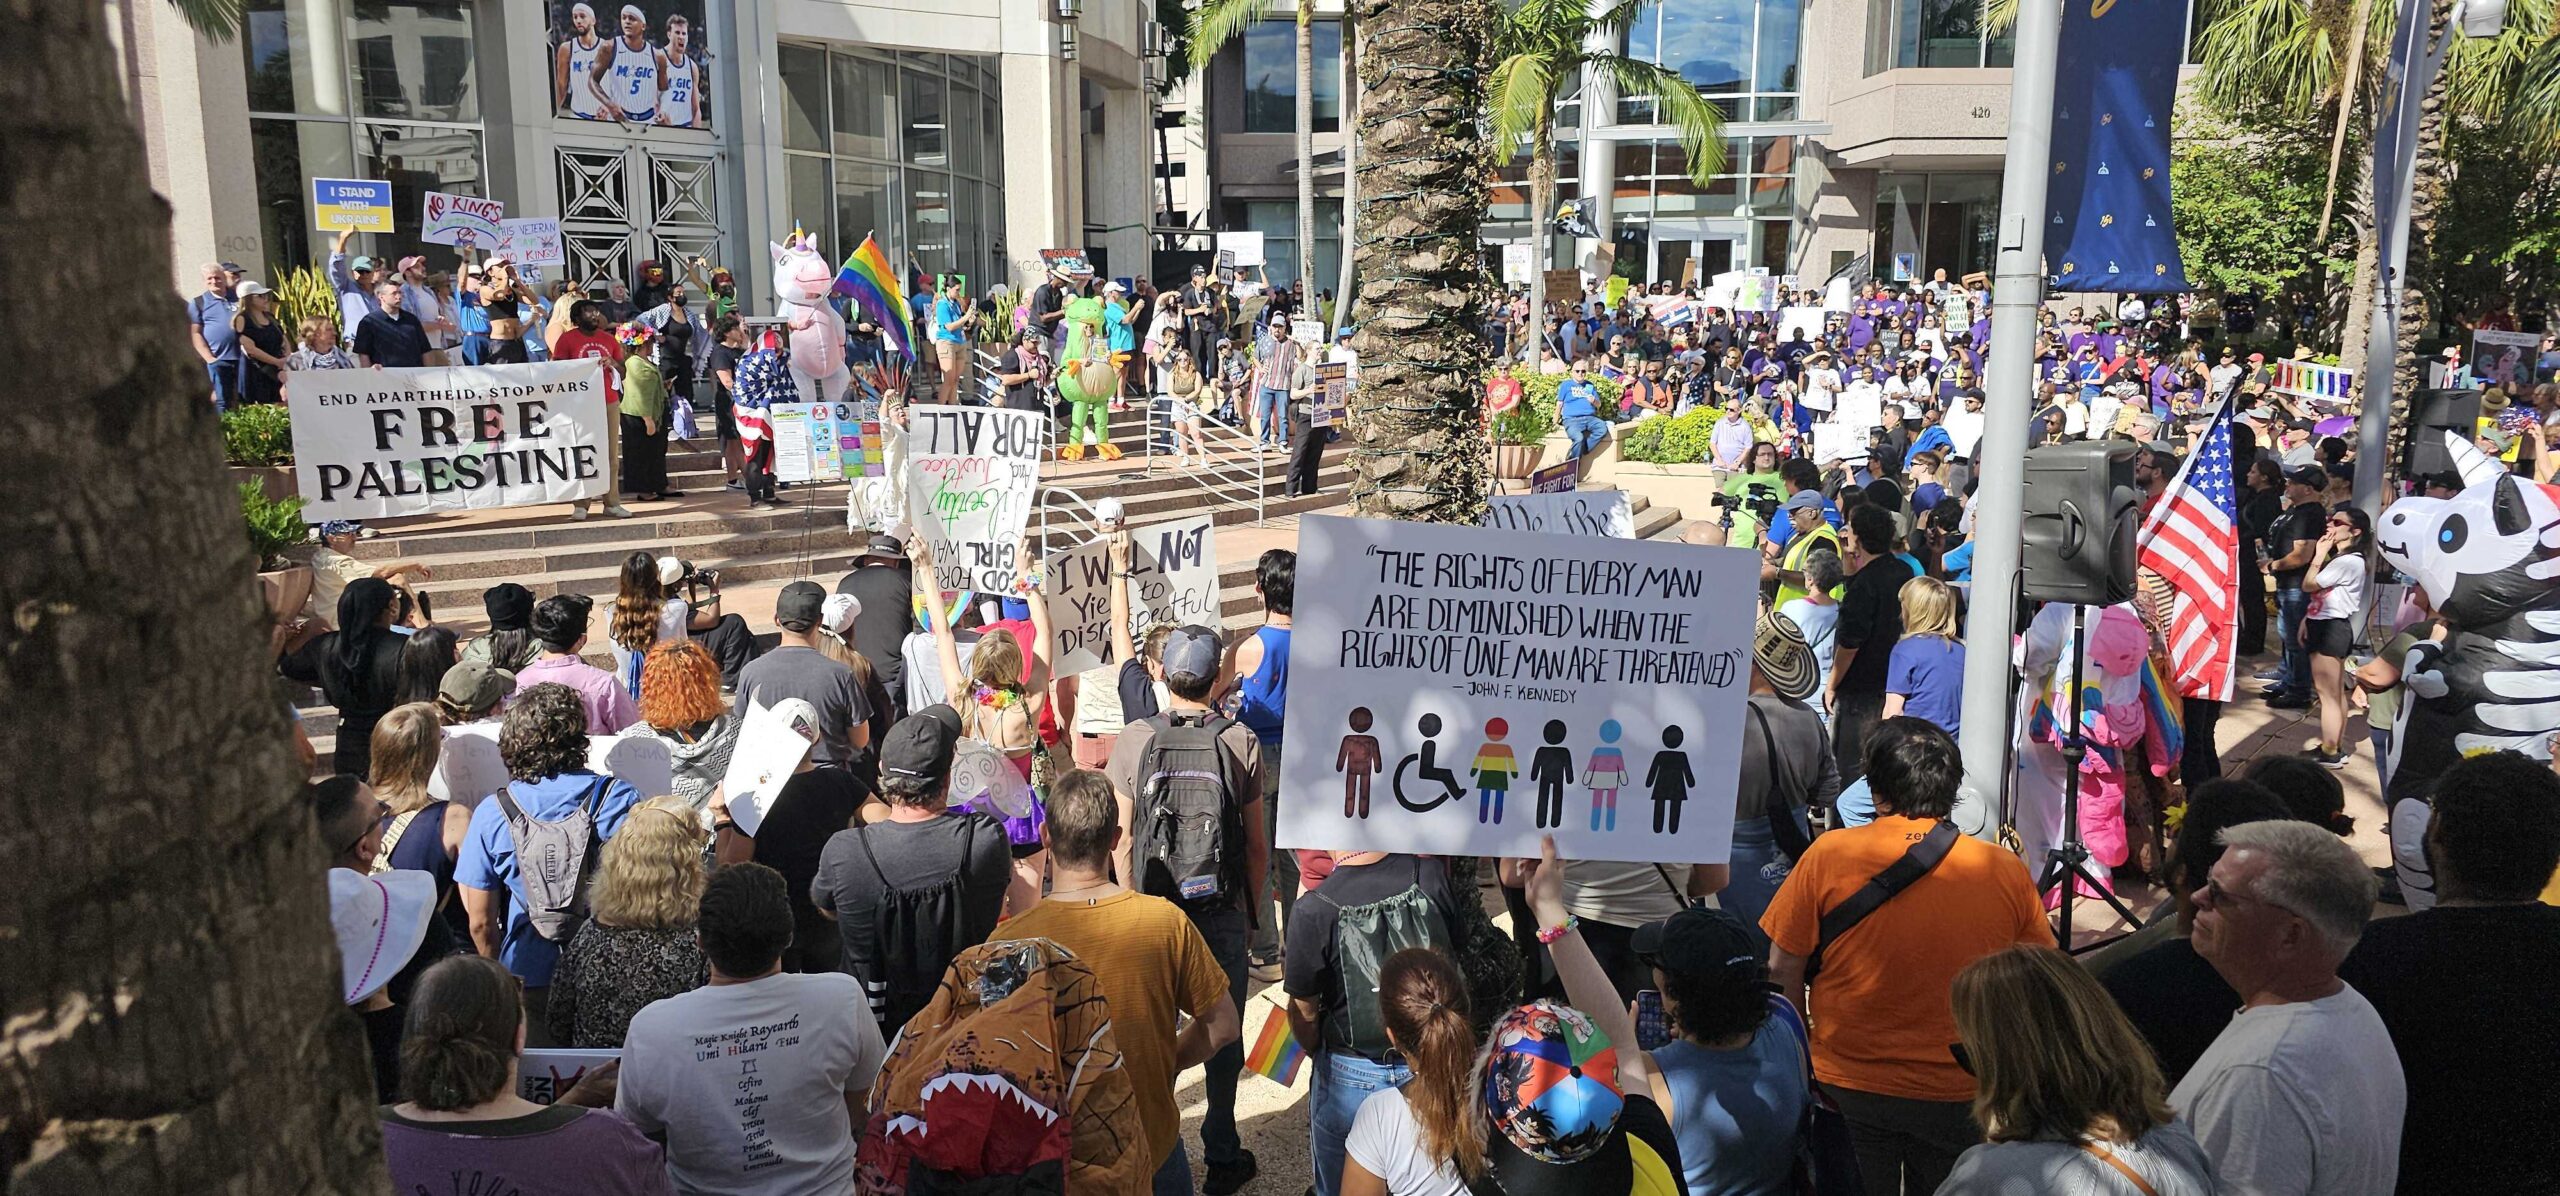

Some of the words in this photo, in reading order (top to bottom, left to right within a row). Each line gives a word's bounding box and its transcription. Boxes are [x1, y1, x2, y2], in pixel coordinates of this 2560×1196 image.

[630, 80, 641, 94] 5
[668, 76, 692, 90] AGIC
[672, 90, 686, 102] 22
[1971, 106, 1991, 118] 420
[330, 186, 335, 197] I
[339, 187, 376, 198] STAND
[340, 200, 369, 211] WITH
[331, 214, 379, 226] UKRAINE
[428, 195, 445, 222] NO
[500, 225, 515, 237] HIS
[518, 222, 556, 236] VETERAN
[222, 236, 257, 252] 400
[1015, 260, 1042, 272] 400
[319, 394, 357, 406] END
[366, 389, 483, 404] APARTHEID,
[489, 386, 535, 399] STOP
[541, 381, 590, 394] WARS
[370, 400, 552, 450] FREE
[919, 411, 985, 455] ALL
[992, 413, 1040, 460] FOR
[316, 445, 600, 501] PALESTINE
[916, 456, 1000, 488] Justice
[1009, 461, 1033, 489] And
[1543, 479, 1561, 493] FIGHT
[1562, 473, 1575, 489] FOR
[924, 468, 1026, 543] Liberty
[1563, 499, 1614, 537] the
[965, 541, 1016, 570] GIRL
[1080, 540, 1152, 588] WL
[1434, 552, 1524, 592] RIGHTS
[1532, 557, 1566, 594] OF
[1566, 559, 1638, 597] EVERY
[1635, 566, 1703, 599] MAN
[1139, 581, 1165, 601] to
[1365, 594, 1420, 629] ARE
[1428, 598, 1573, 639] DIMINISHED
[1579, 607, 1643, 642] WHEN
[1642, 611, 1692, 644] THE
[1340, 629, 1427, 669] RIGHTS
[1429, 635, 1462, 673] OF
[1463, 638, 1511, 678] ONE
[1512, 644, 1563, 680] MAN
[1566, 645, 1609, 685] ARE
[1467, 681, 1500, 697] JOHN
[1504, 684, 1514, 699] F.
[1518, 686, 1578, 703] KENNEDY
[545, 843, 556, 884] CAMELBAK
[694, 1033, 718, 1048] Magic
[720, 1030, 748, 1044] Knight
[750, 1013, 800, 1041] Rayearth
[696, 1047, 720, 1062] Umi
[727, 1040, 768, 1056] Hikaru
[775, 1035, 800, 1049] Fuu
[738, 1076, 763, 1092] Cefiro
[734, 1092, 769, 1106] Mokona
